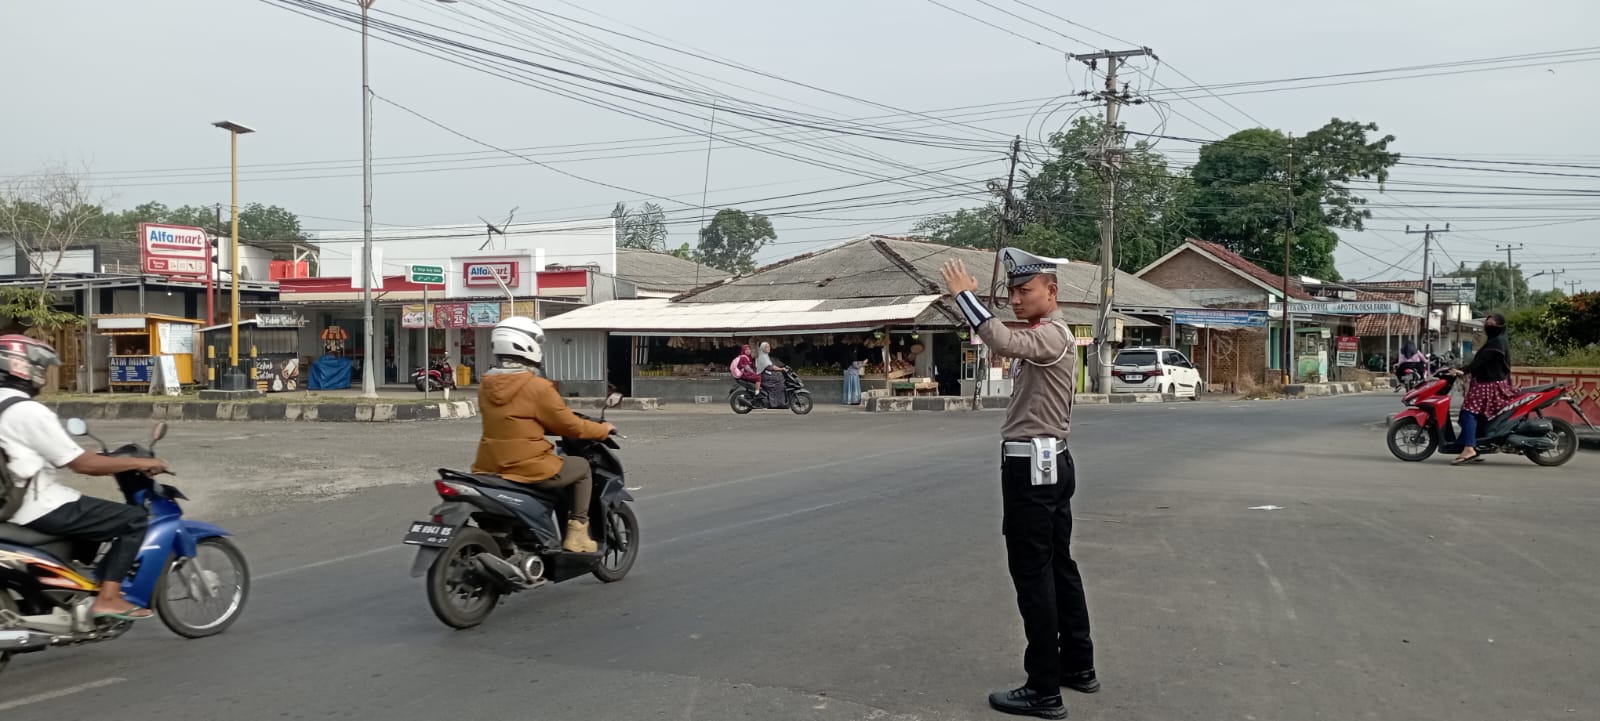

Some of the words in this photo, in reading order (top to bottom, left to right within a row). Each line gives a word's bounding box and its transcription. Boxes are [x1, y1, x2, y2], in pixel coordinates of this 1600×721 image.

[150, 230, 202, 245] Alfamart
[1336, 303, 1358, 311] APOTEK
[1374, 303, 1392, 311] FARMA
[110, 357, 127, 366] ATM
[128, 357, 148, 366] MINI
